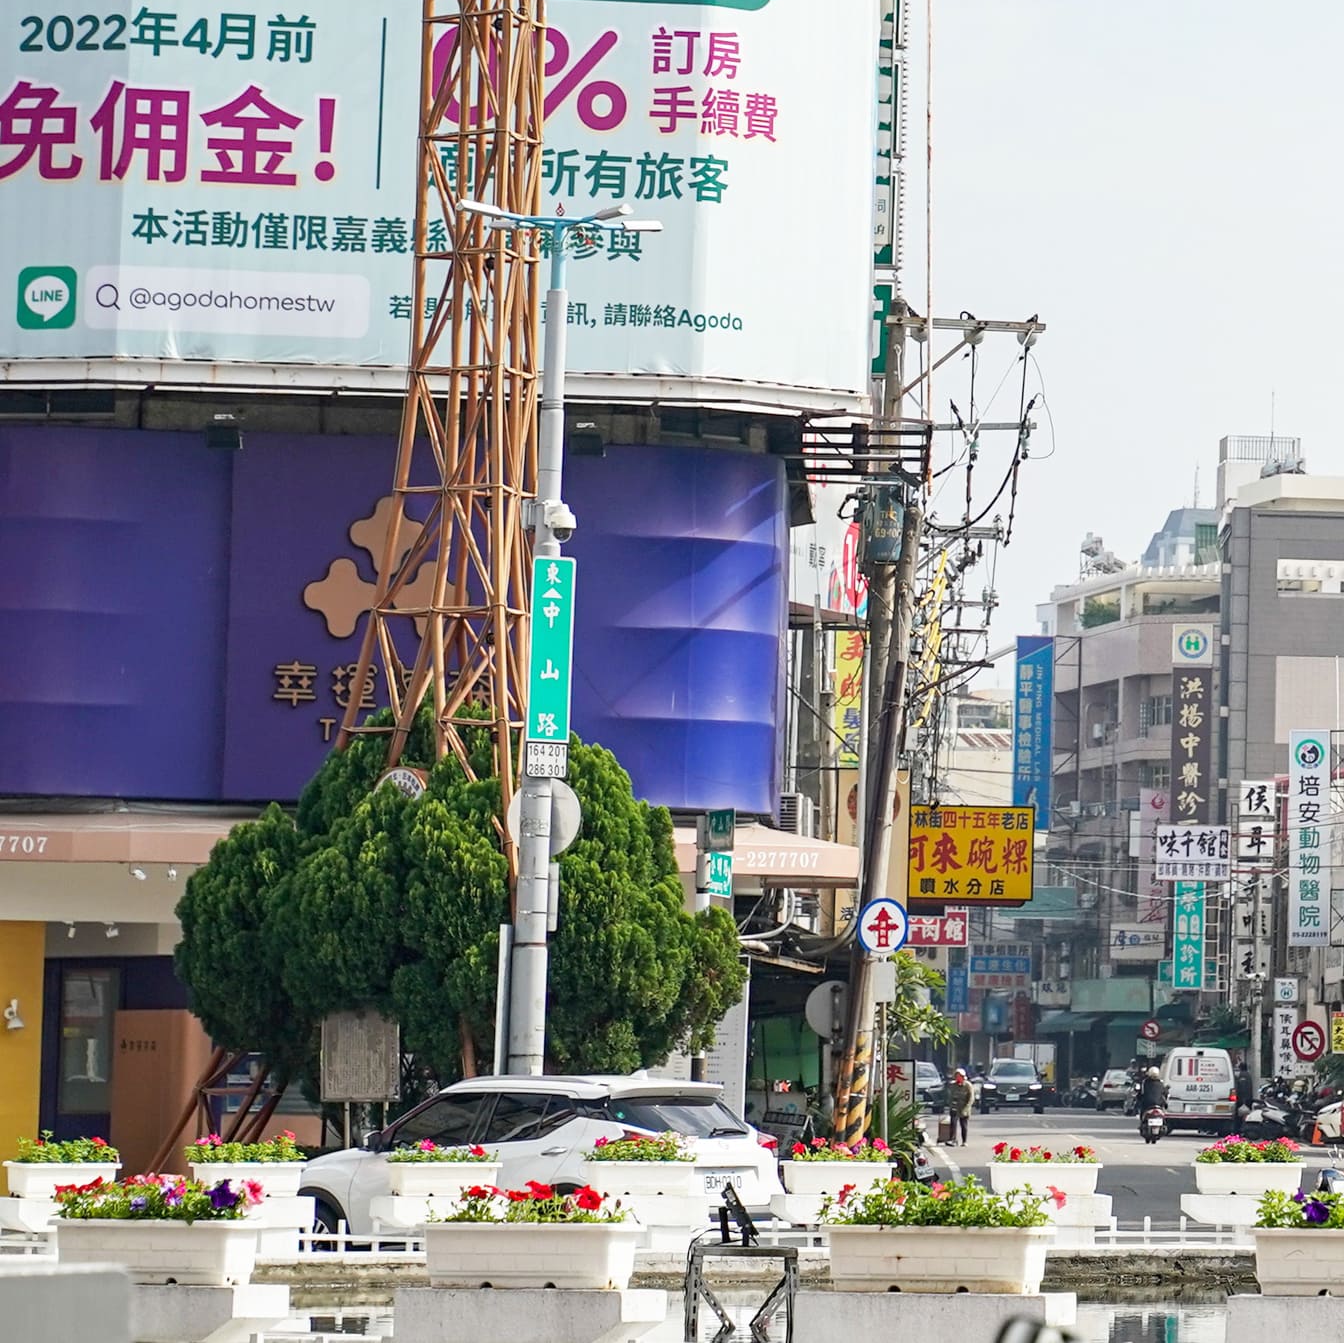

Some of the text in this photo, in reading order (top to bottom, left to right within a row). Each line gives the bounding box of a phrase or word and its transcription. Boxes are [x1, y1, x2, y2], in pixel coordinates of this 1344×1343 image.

[19, 6, 317, 64] 2022年4月前
[652, 27, 742, 80] 訂房
[0, 80, 337, 187] 免佣金!
[649, 84, 779, 144] 手續費
[31, 289, 63, 303] LINE
[129, 287, 335, 313] @agodahomestw
[545, 562, 562, 585] 東
[537, 601, 561, 737] 中山路
[529, 744, 566, 757] 164 201
[1035, 713, 1043, 755] MEDICAL
[1178, 677, 1205, 824] 洪揚中醫診
[528, 764, 566, 776] 286 301
[911, 811, 1029, 830] 林街四十五年老店
[1298, 776, 1320, 927] 培安動物醫院
[920, 878, 1005, 895] 噴水分店
